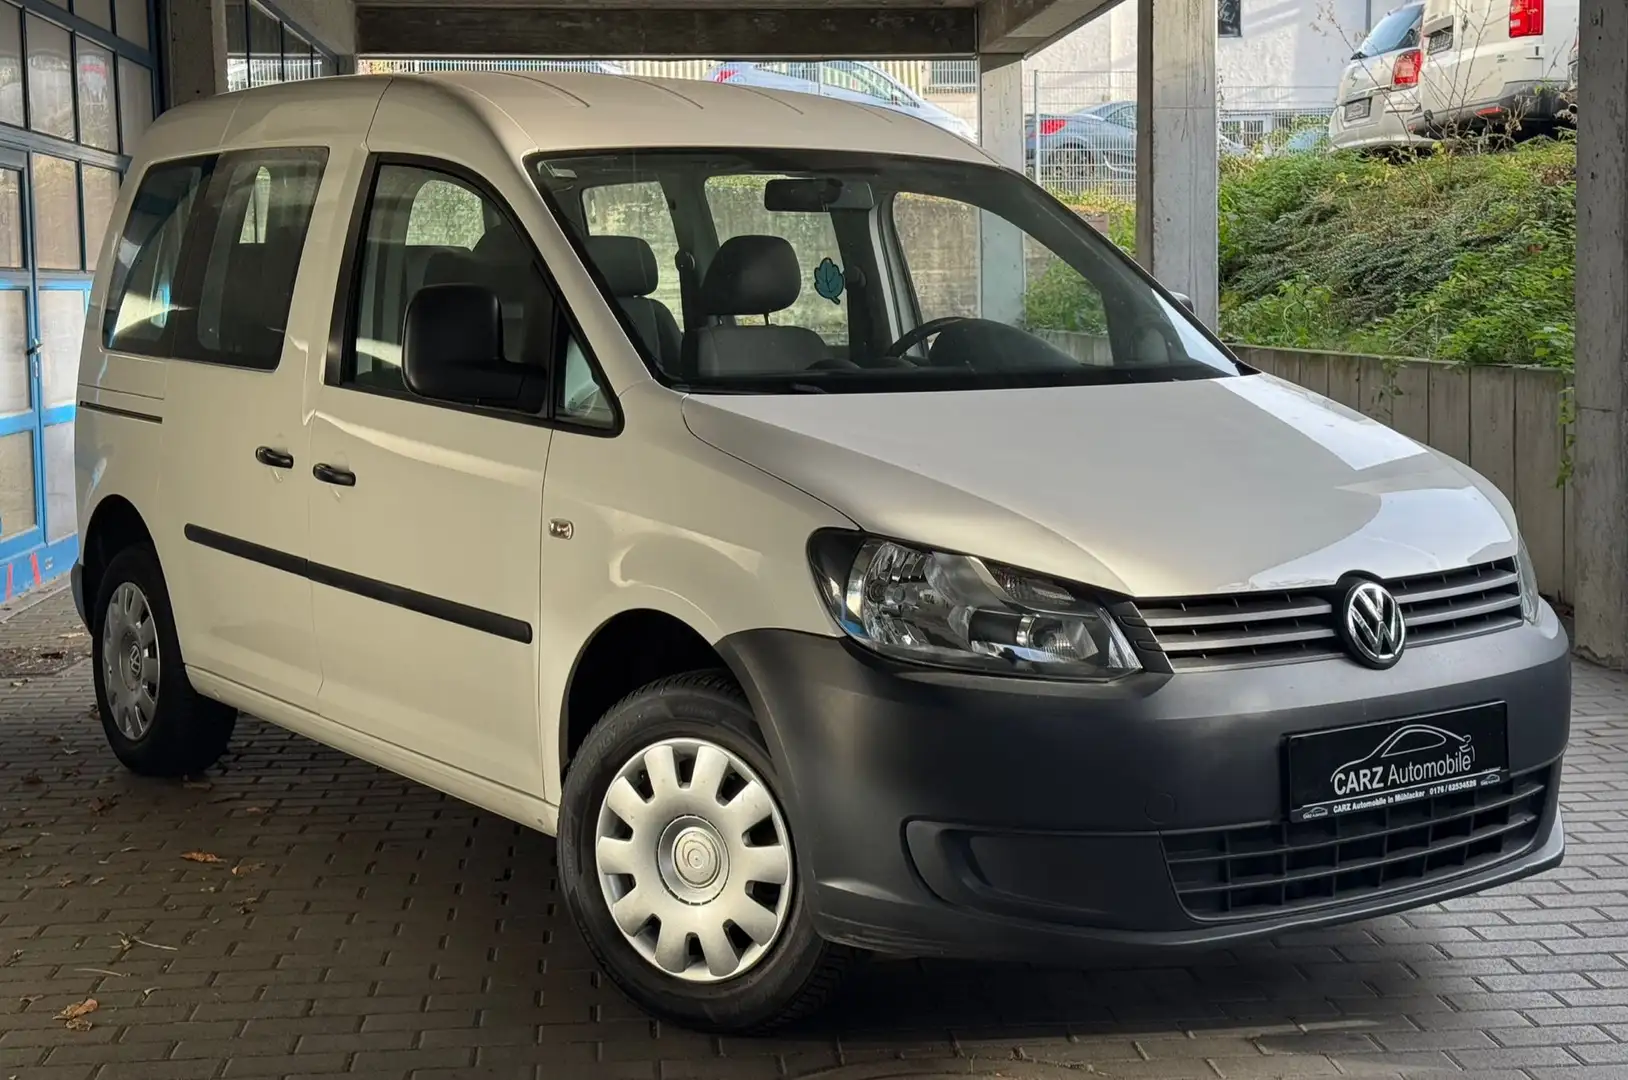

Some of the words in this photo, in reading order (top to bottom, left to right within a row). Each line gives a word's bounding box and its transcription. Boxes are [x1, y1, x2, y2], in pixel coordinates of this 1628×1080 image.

[1334, 766, 1384, 795] CARZ
[1388, 752, 1471, 786] Automobile
[1333, 803, 1351, 813] CARZ
[1352, 798, 1387, 810] Automobile
[1387, 796, 1394, 804] in
